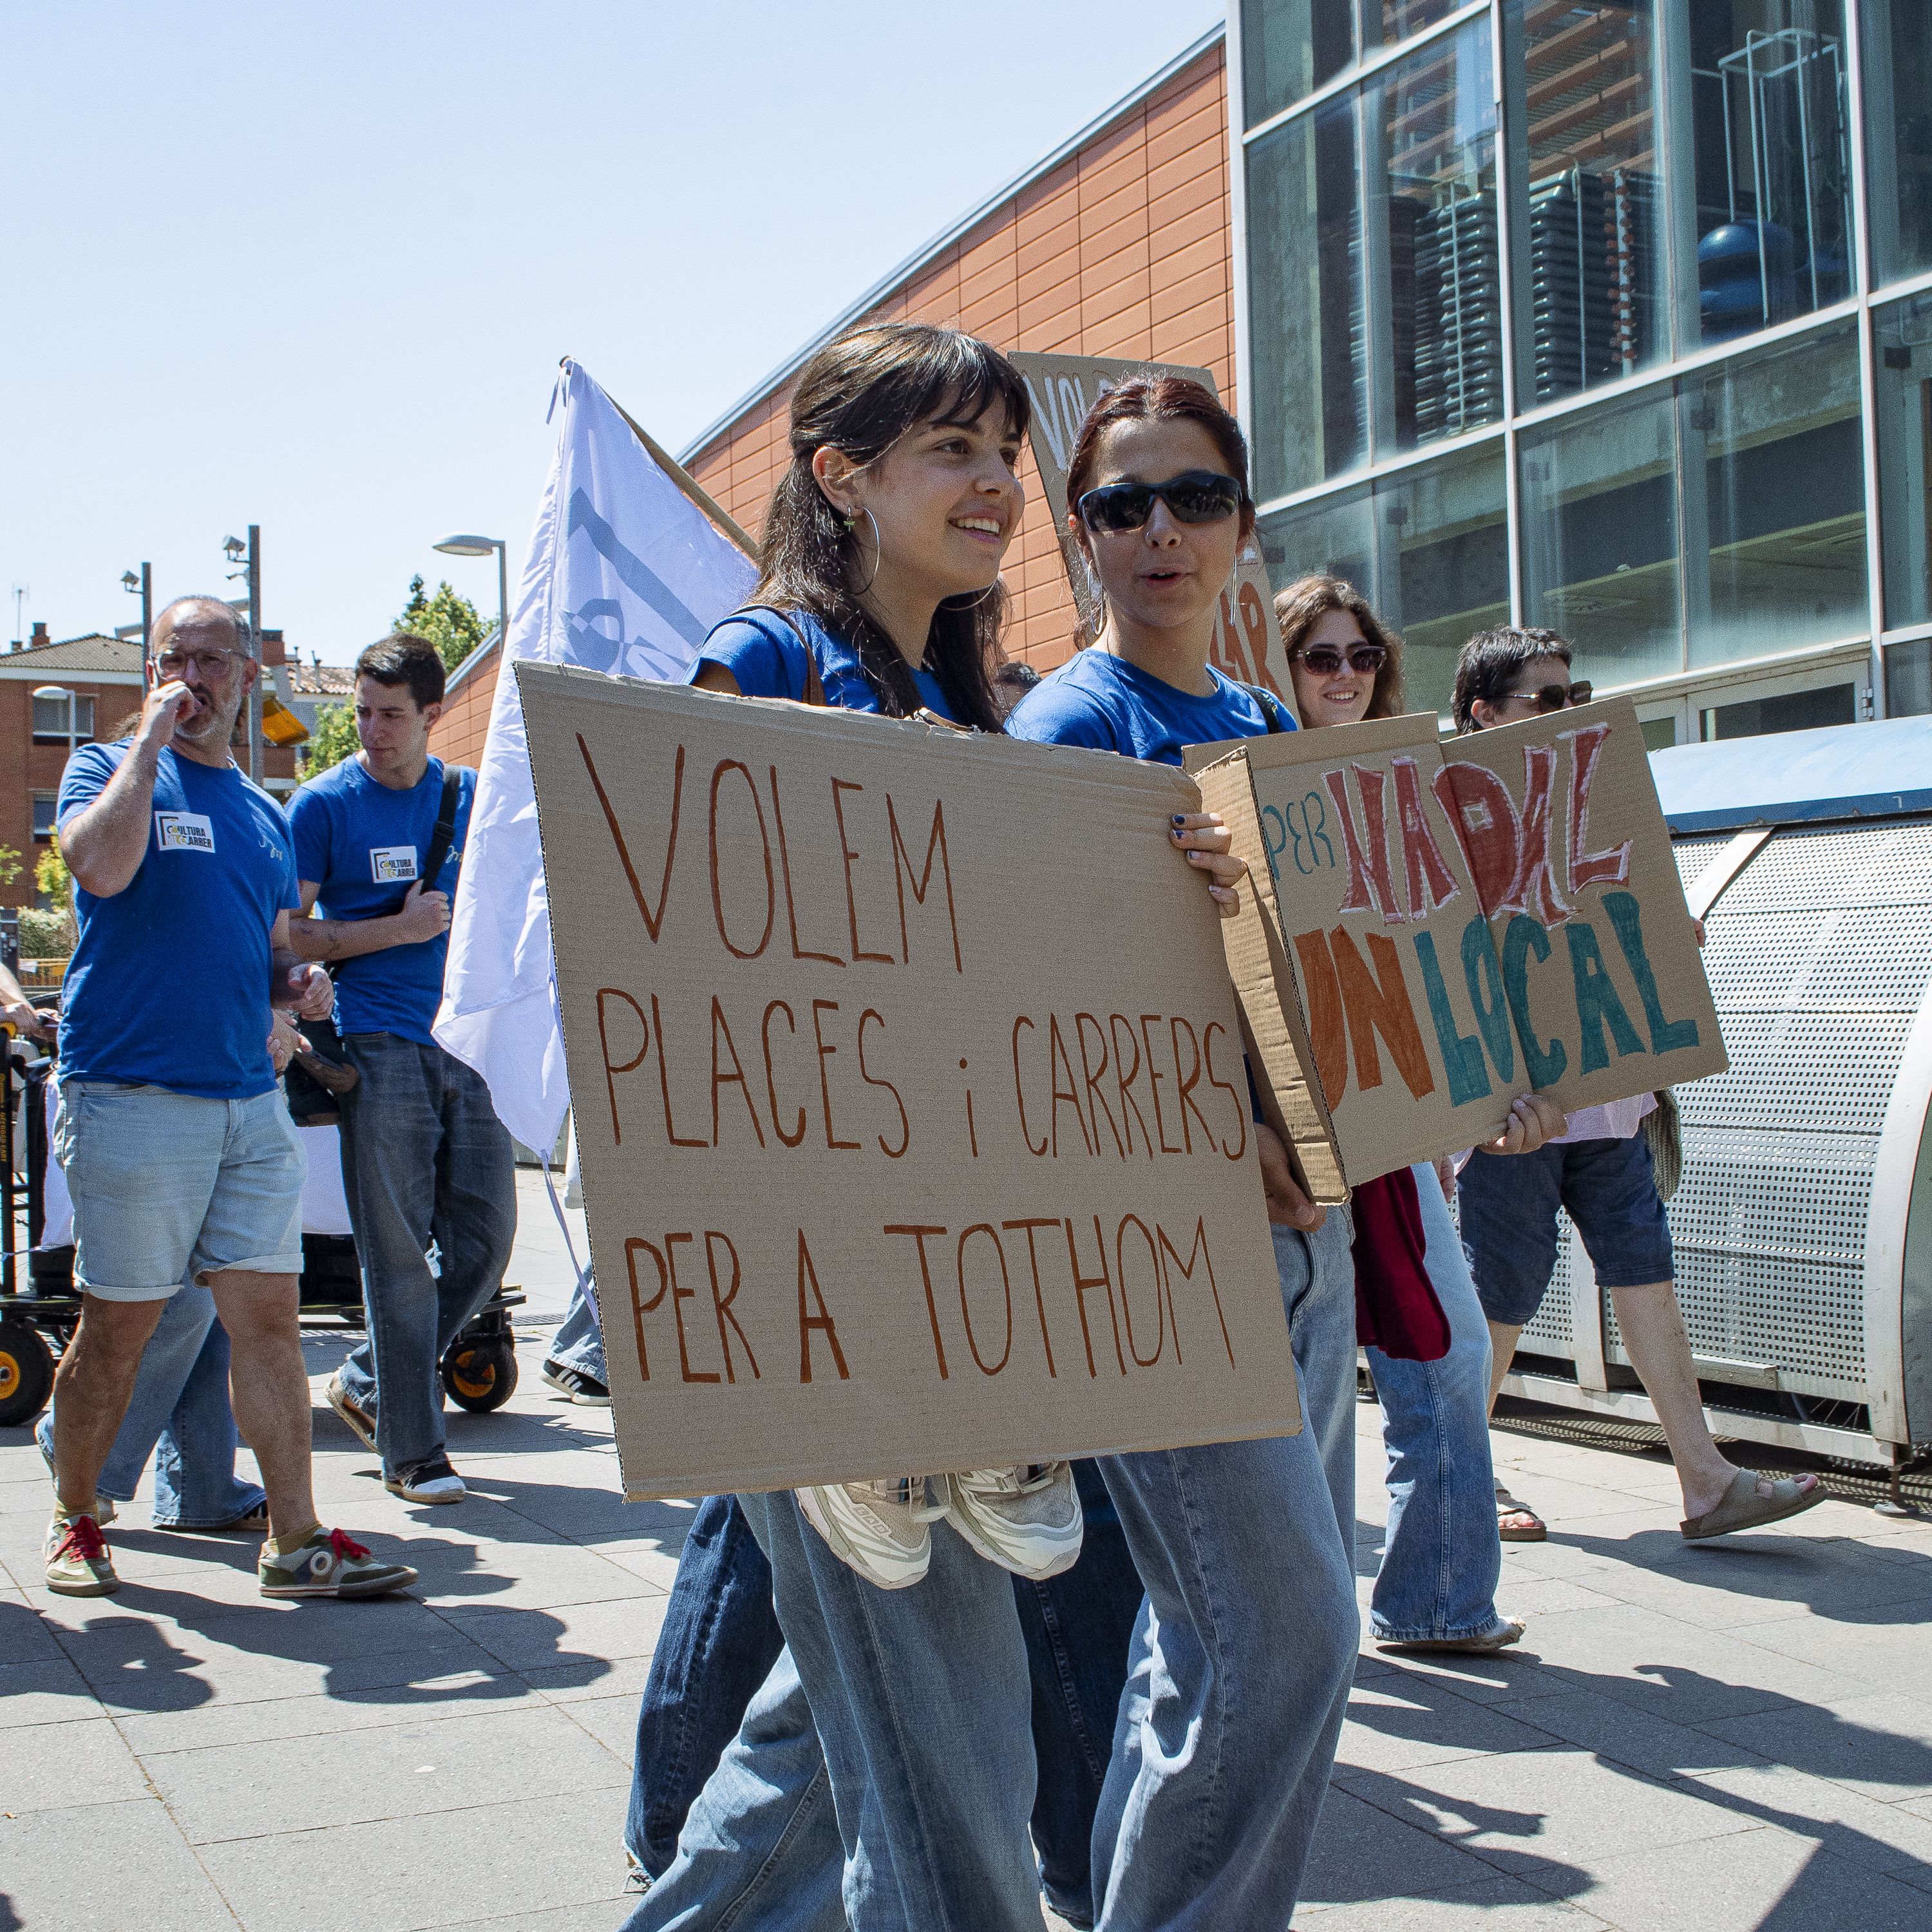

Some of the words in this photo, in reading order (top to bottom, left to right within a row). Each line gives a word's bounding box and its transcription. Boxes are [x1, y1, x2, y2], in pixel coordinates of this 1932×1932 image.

[575, 732, 963, 973] VOLEM
[1263, 791, 1336, 882] PER
[1321, 722, 1634, 931] NADAL
[595, 987, 909, 1159] PLACES
[960, 1057, 978, 1158] i
[1012, 1012, 1246, 1161] CARRERS
[1293, 923, 1435, 1113] UN
[1413, 891, 1700, 1108] LOCAL
[623, 1230, 761, 1385] PER
[799, 1227, 850, 1384] A
[883, 1213, 1236, 1380] TOTHOM
